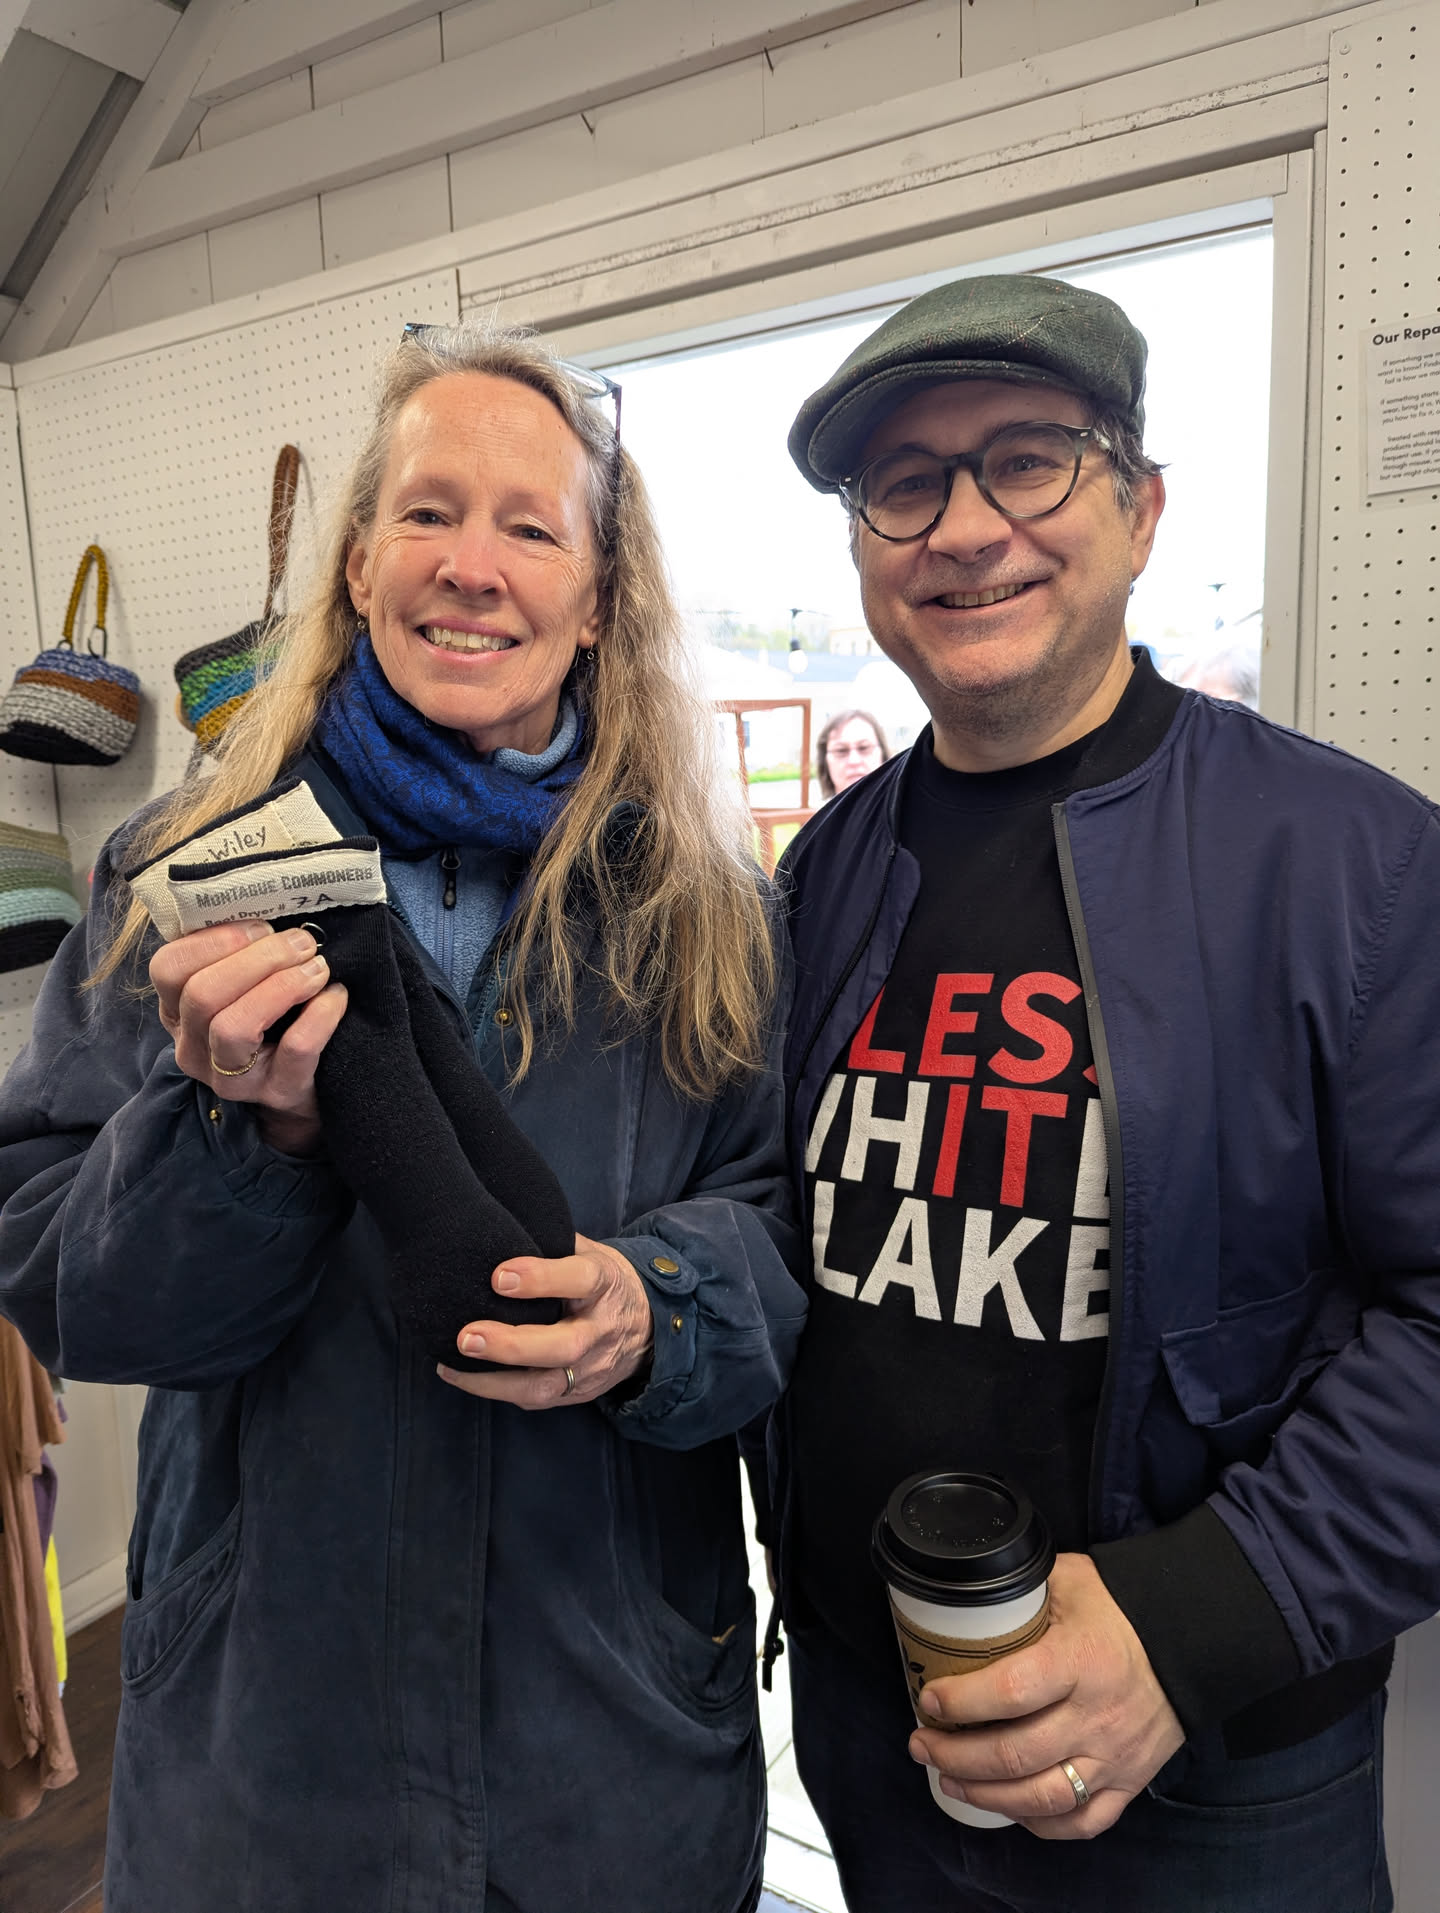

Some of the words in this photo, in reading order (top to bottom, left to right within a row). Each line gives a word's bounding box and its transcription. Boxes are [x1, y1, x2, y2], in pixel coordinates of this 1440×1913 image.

[1373, 334, 1399, 345] Our
[208, 826, 267, 860] Wiley
[196, 880, 278, 908] MONTAGUE
[281, 868, 374, 890] COMMONERS
[238, 907, 275, 918] Dryer
[847, 971, 1099, 1086] LES
